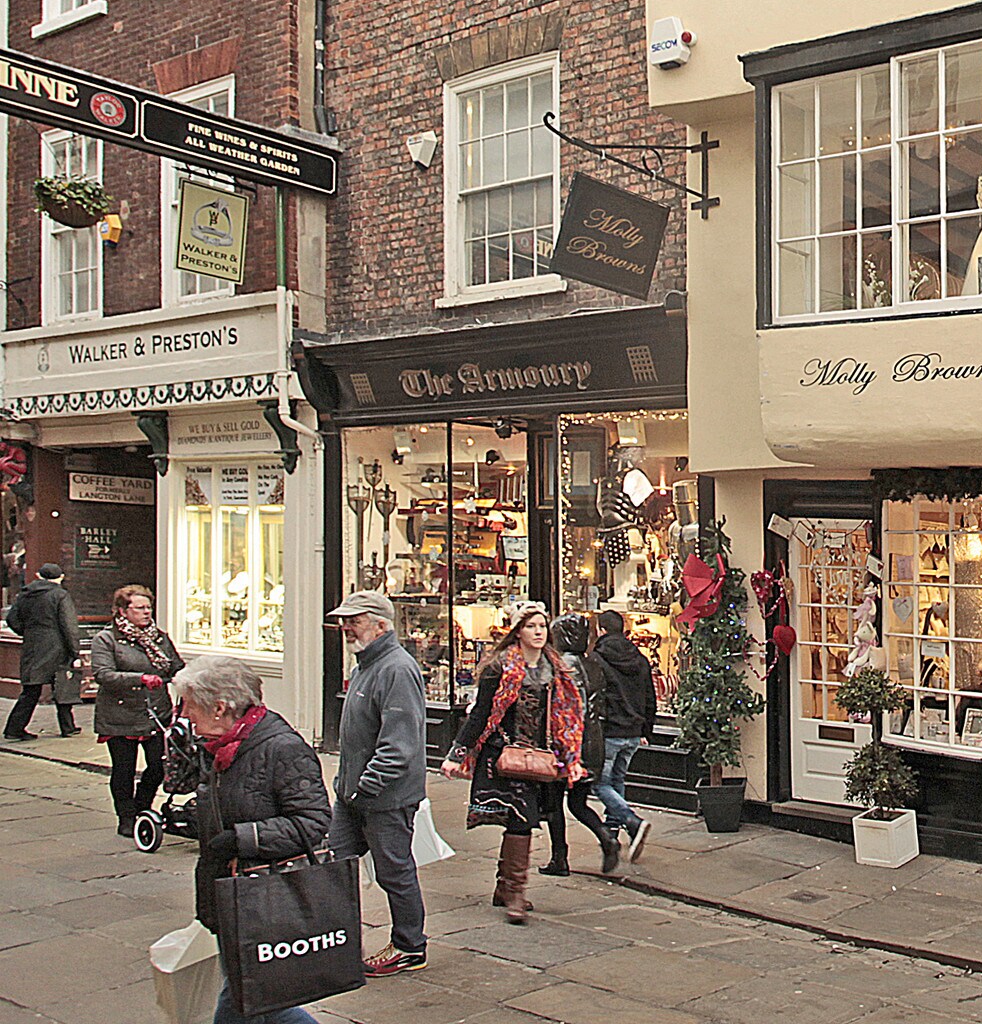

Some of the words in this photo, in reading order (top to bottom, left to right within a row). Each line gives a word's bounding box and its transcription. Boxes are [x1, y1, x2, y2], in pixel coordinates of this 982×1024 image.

[651, 38, 677, 52] SECOM
[0, 60, 79, 108] INNE
[185, 136, 206, 148] ALL
[208, 142, 258, 164] WEATHER
[260, 157, 300, 176] GARDEN
[188, 122, 211, 136] FINE
[214, 130, 247, 147] WINES
[249, 141, 258, 150] &
[260, 144, 298, 162] SPIRITS
[583, 208, 644, 249] Molly
[229, 254, 238, 263] &
[566, 236, 646, 275] Browns
[134, 336, 146, 356] &
[399, 368, 454, 400] The
[458, 360, 592, 393] Armoury
[800, 357, 877, 395] Molly
[189, 425, 199, 434] WE
[202, 423, 214, 433] BUY
[215, 424, 221, 432] &
[223, 422, 238, 432] SELL
[241, 420, 259, 430] GOLD
[72, 474, 115, 487] COFFEE
[121, 479, 152, 490] YARD
[79, 491, 120, 501] LANGTON
[124, 494, 145, 503] LANE
[80, 527, 117, 536] BARLEY
[257, 929, 347, 962] BOOTHS
